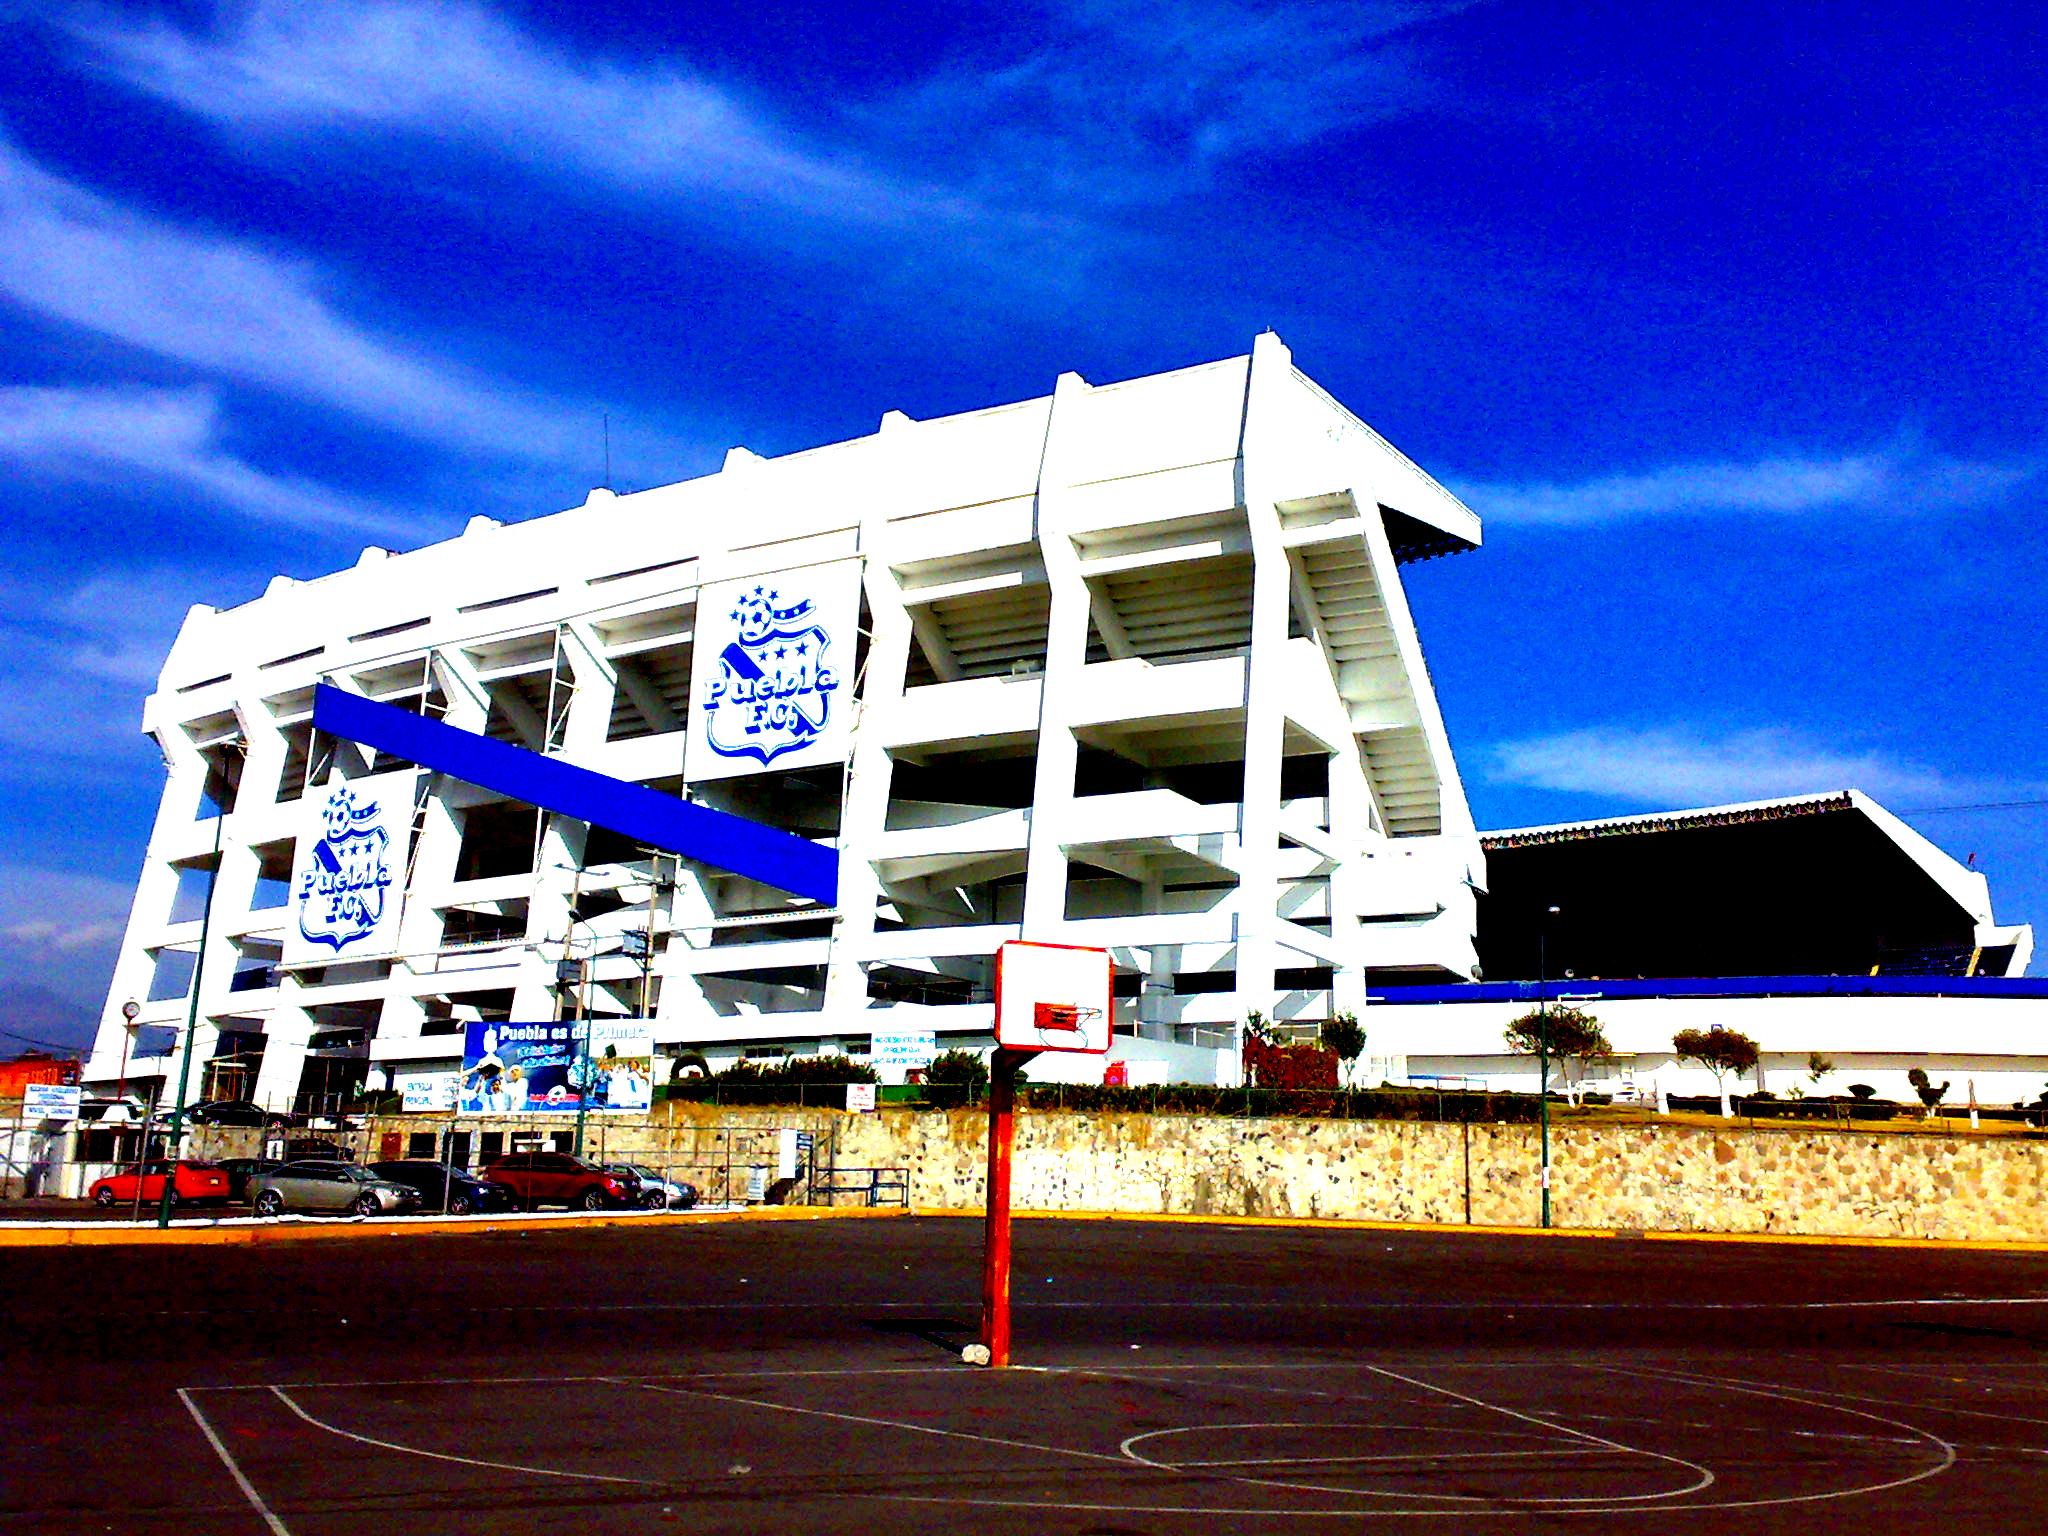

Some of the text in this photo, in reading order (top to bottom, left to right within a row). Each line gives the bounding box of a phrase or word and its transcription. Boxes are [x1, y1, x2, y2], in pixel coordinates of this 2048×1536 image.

[703, 664, 839, 710] Puebla
[299, 862, 392, 899] Puebla
[499, 1024, 548, 1041] Puebla
[551, 1027, 568, 1040] es
